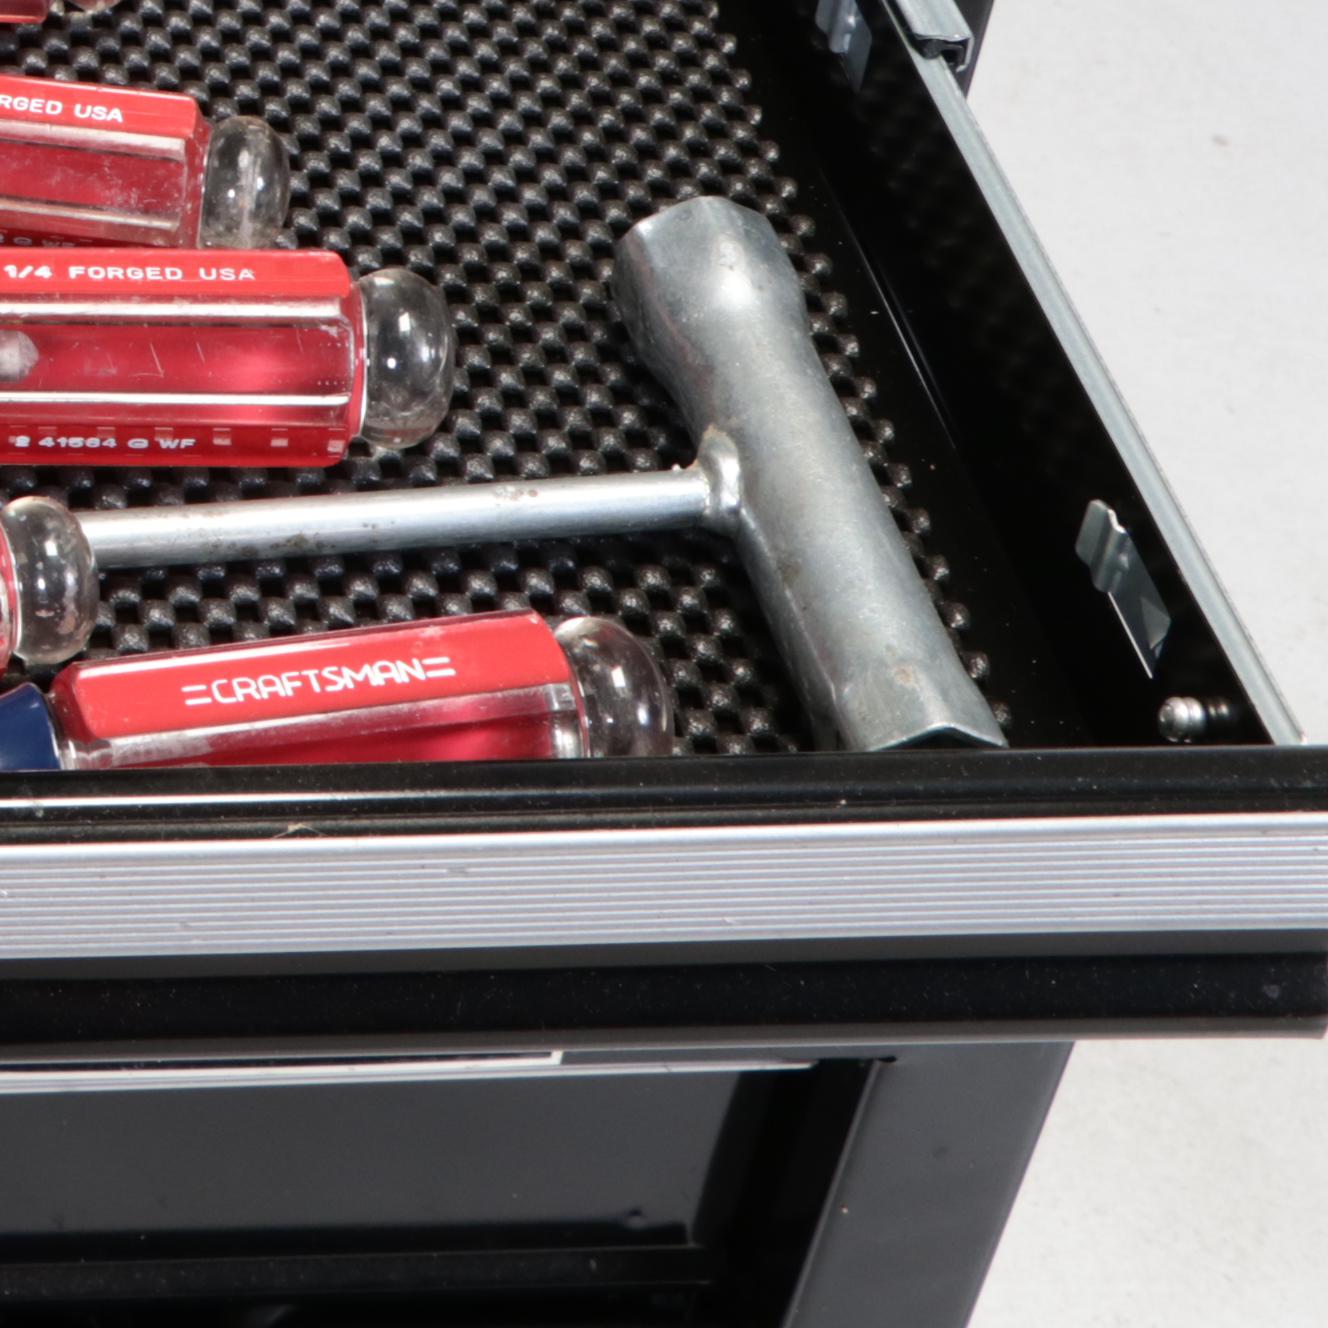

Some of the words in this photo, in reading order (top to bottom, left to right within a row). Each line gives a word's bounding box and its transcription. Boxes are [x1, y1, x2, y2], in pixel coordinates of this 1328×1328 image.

[74, 103, 124, 124] USA
[3, 264, 52, 279] 1/4
[67, 265, 183, 281] FORGED
[197, 267, 256, 283] USA
[210, 656, 426, 706] CRAFTSMAN
